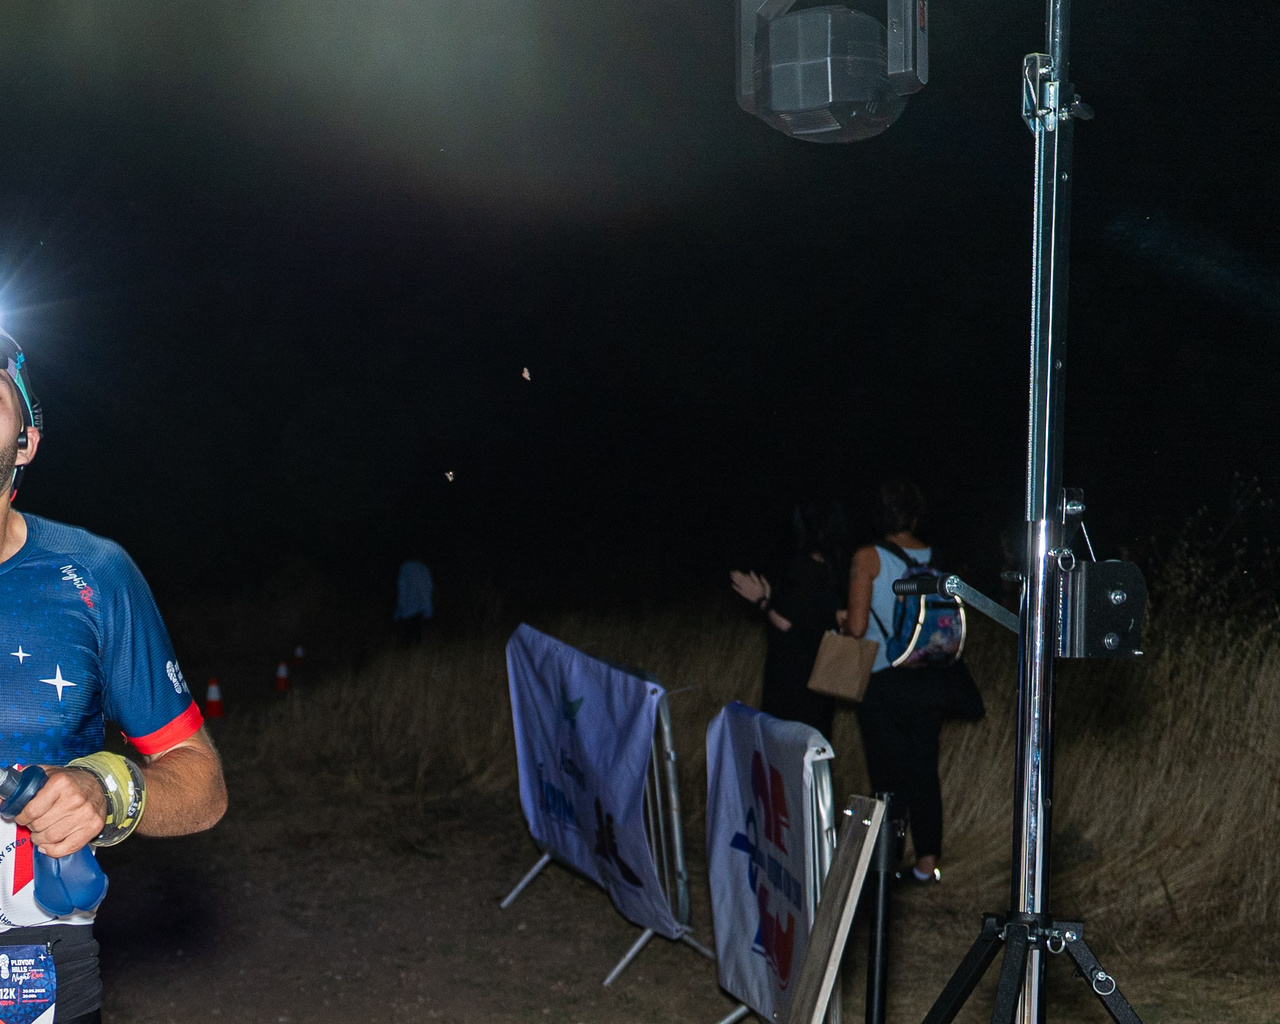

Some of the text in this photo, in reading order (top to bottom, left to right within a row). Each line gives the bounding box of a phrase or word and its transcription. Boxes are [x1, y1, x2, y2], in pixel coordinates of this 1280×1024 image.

[60, 565, 87, 589] Night
[5, 837, 27, 853] STEP
[0, 988, 16, 999] 12K
